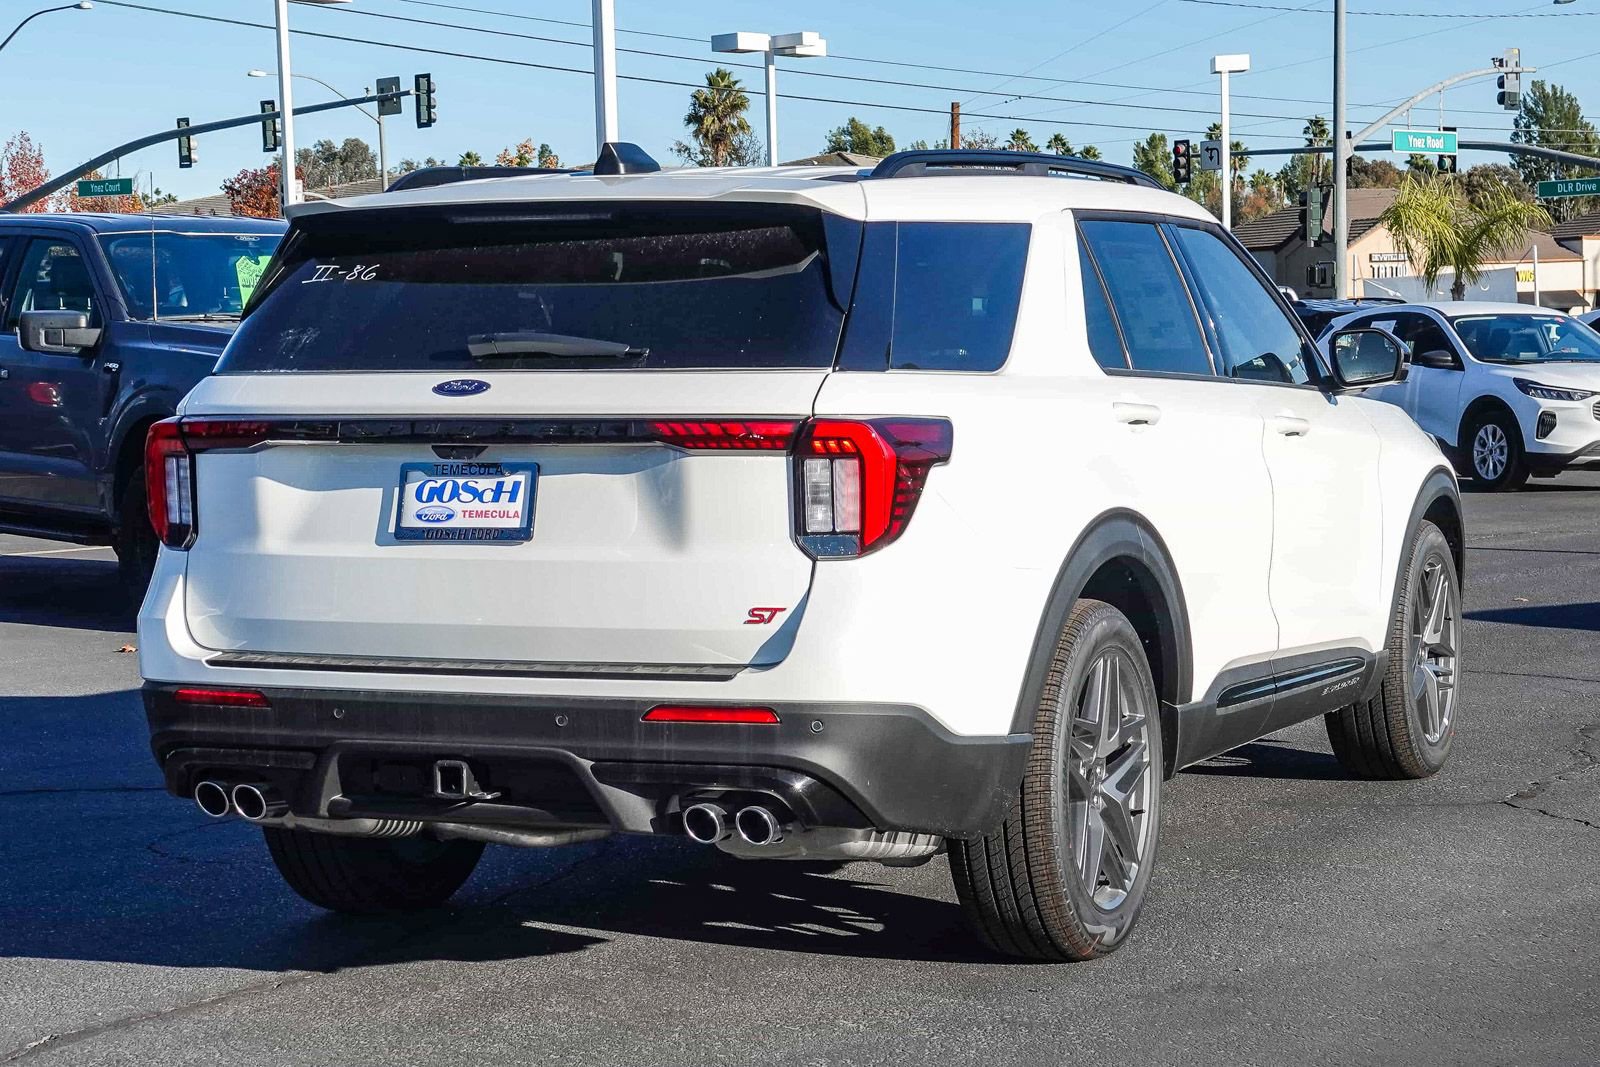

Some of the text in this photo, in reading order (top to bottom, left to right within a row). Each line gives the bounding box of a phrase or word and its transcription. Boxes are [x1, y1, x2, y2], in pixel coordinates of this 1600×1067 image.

[1408, 134, 1444, 149] Ynez Road
[90, 182, 121, 193] Ynez Court
[1557, 182, 1597, 193] DLR Drive
[434, 464, 503, 476] TEMECULA
[461, 509, 520, 519] TEMECULA
[743, 607, 787, 624] ST
